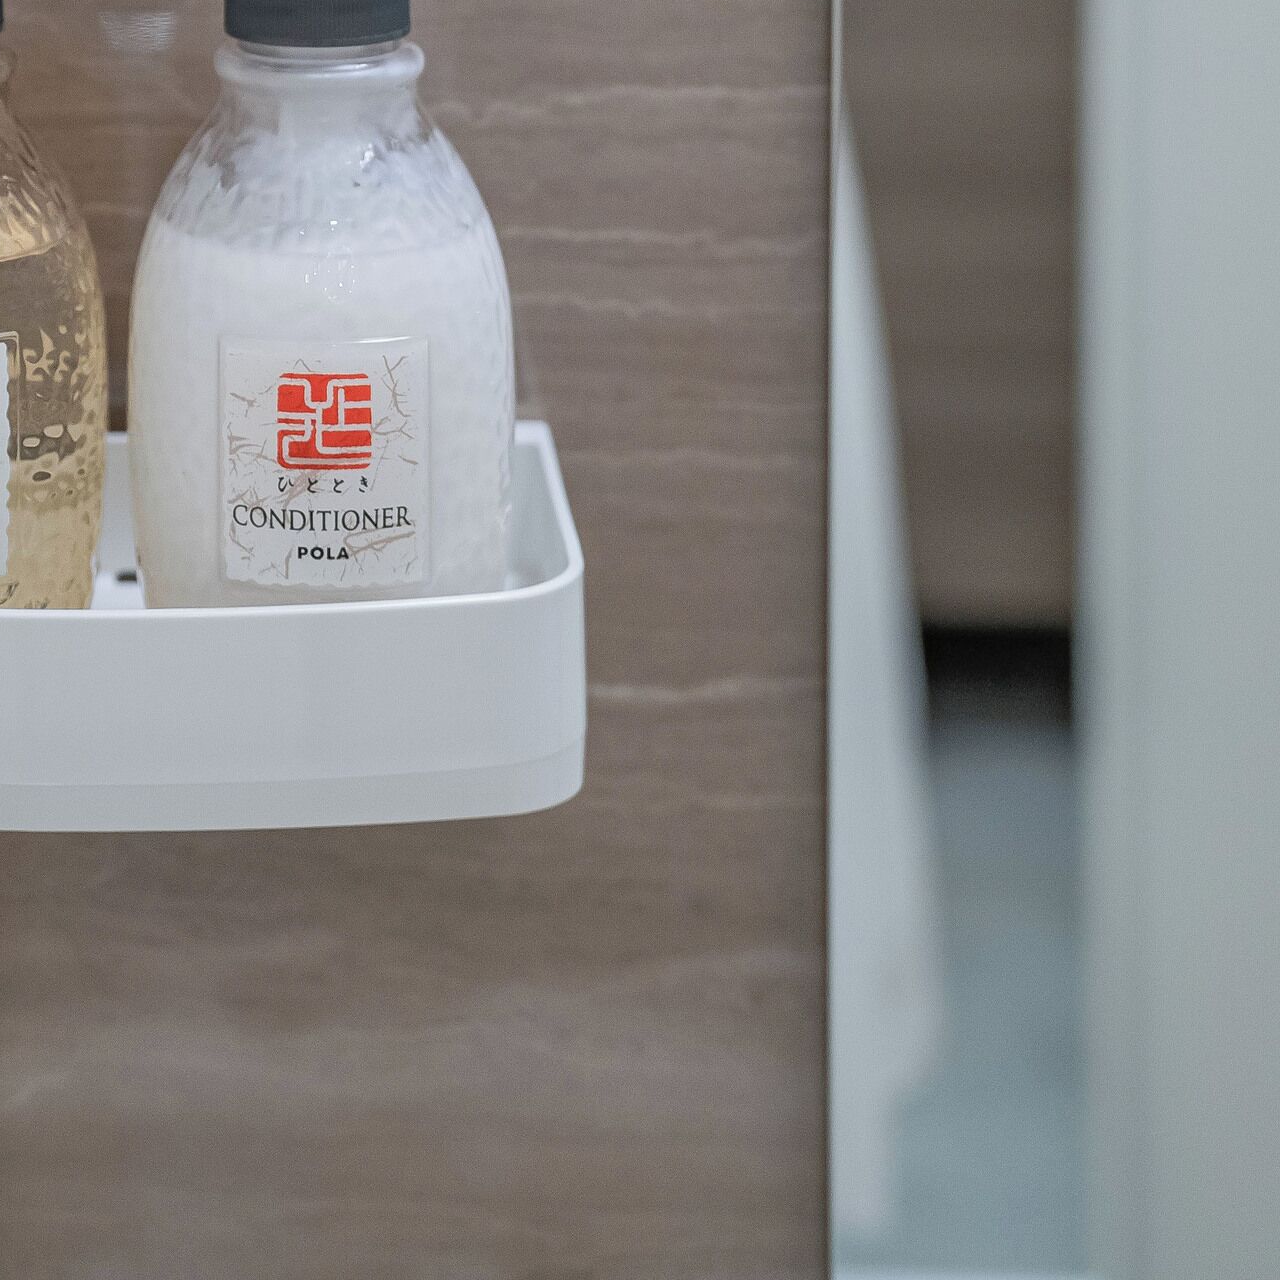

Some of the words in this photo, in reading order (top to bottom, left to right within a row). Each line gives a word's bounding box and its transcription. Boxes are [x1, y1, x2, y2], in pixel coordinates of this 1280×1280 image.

[277, 475, 369, 494] ひととき
[232, 504, 412, 532] CONDITIONER
[297, 546, 350, 561] POLA
